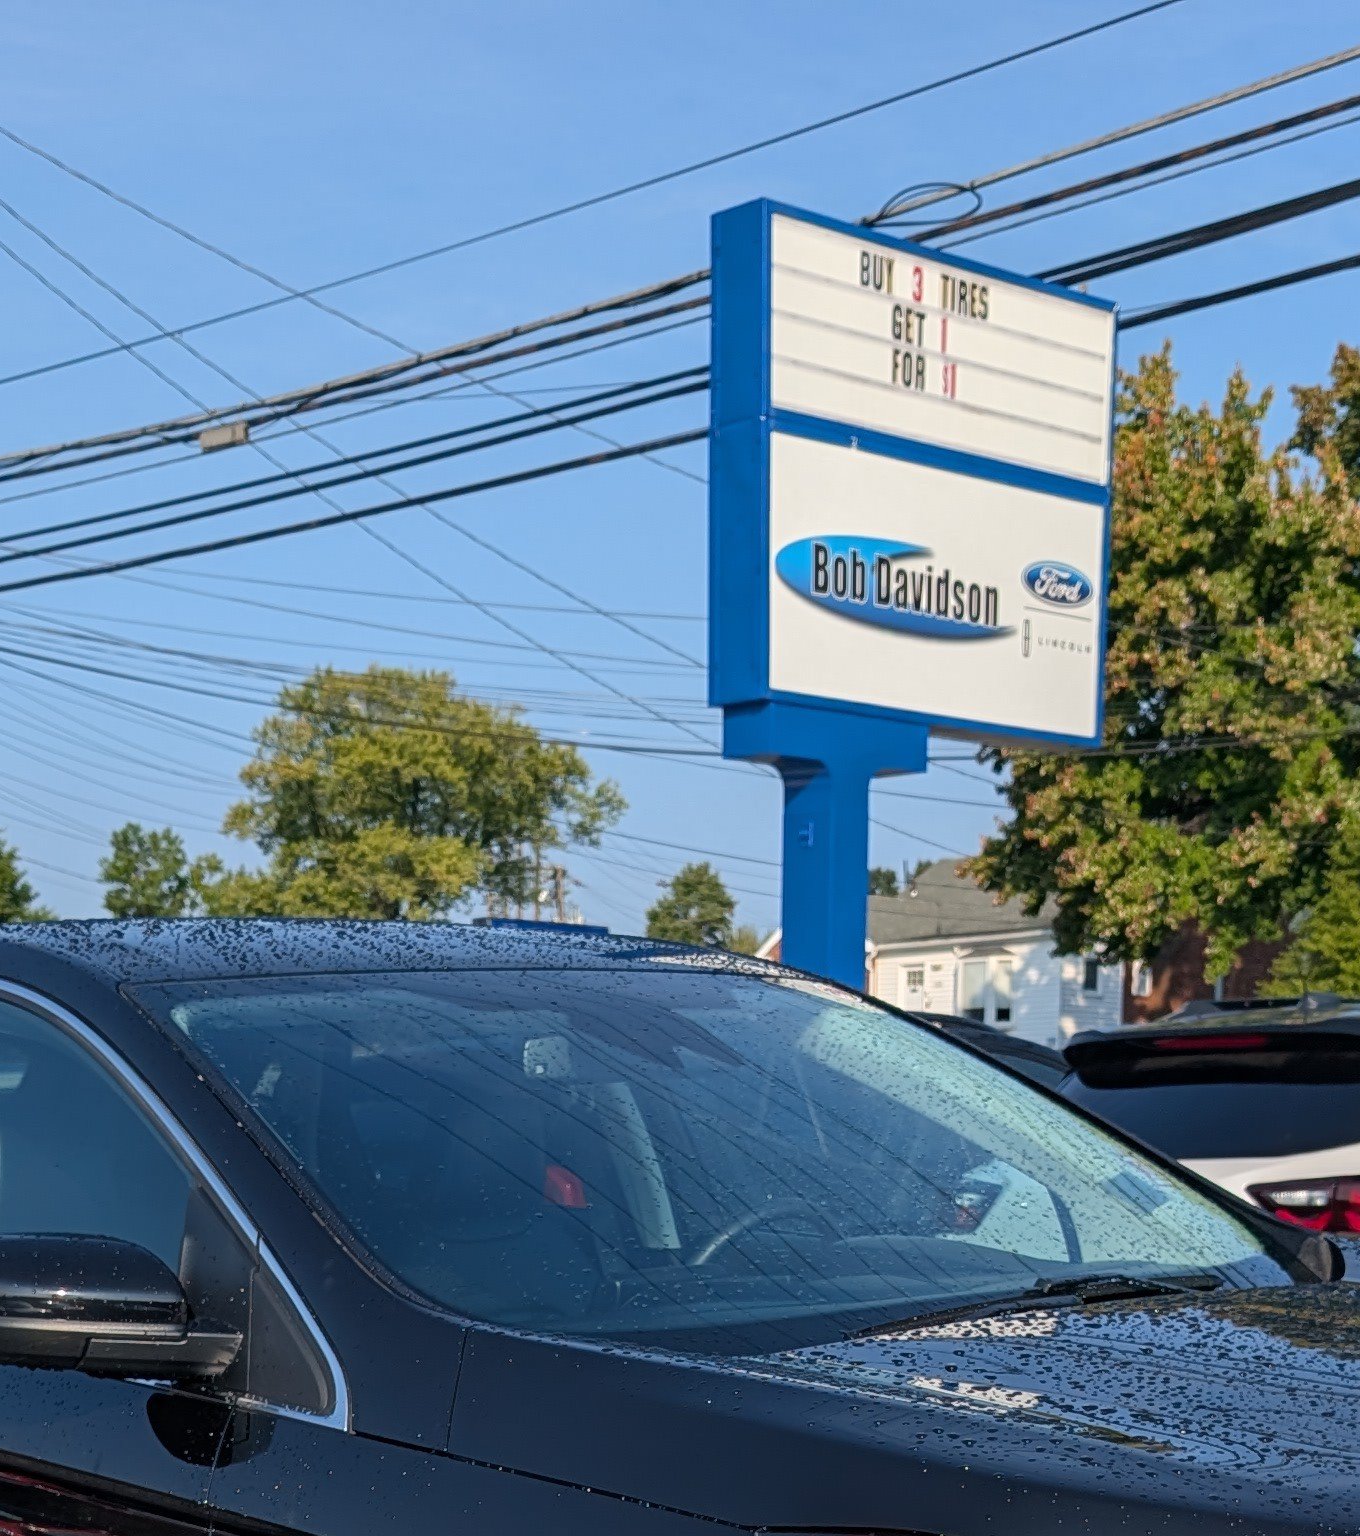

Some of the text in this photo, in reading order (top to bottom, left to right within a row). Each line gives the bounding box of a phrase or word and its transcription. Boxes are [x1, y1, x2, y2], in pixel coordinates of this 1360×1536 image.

[859, 250, 990, 320] BUY 3 TIRES
[891, 304, 927, 348] GET
[891, 348, 957, 399] FOR $1
[813, 542, 999, 627] Bob Davidson
[1034, 566, 1082, 603] Ford
